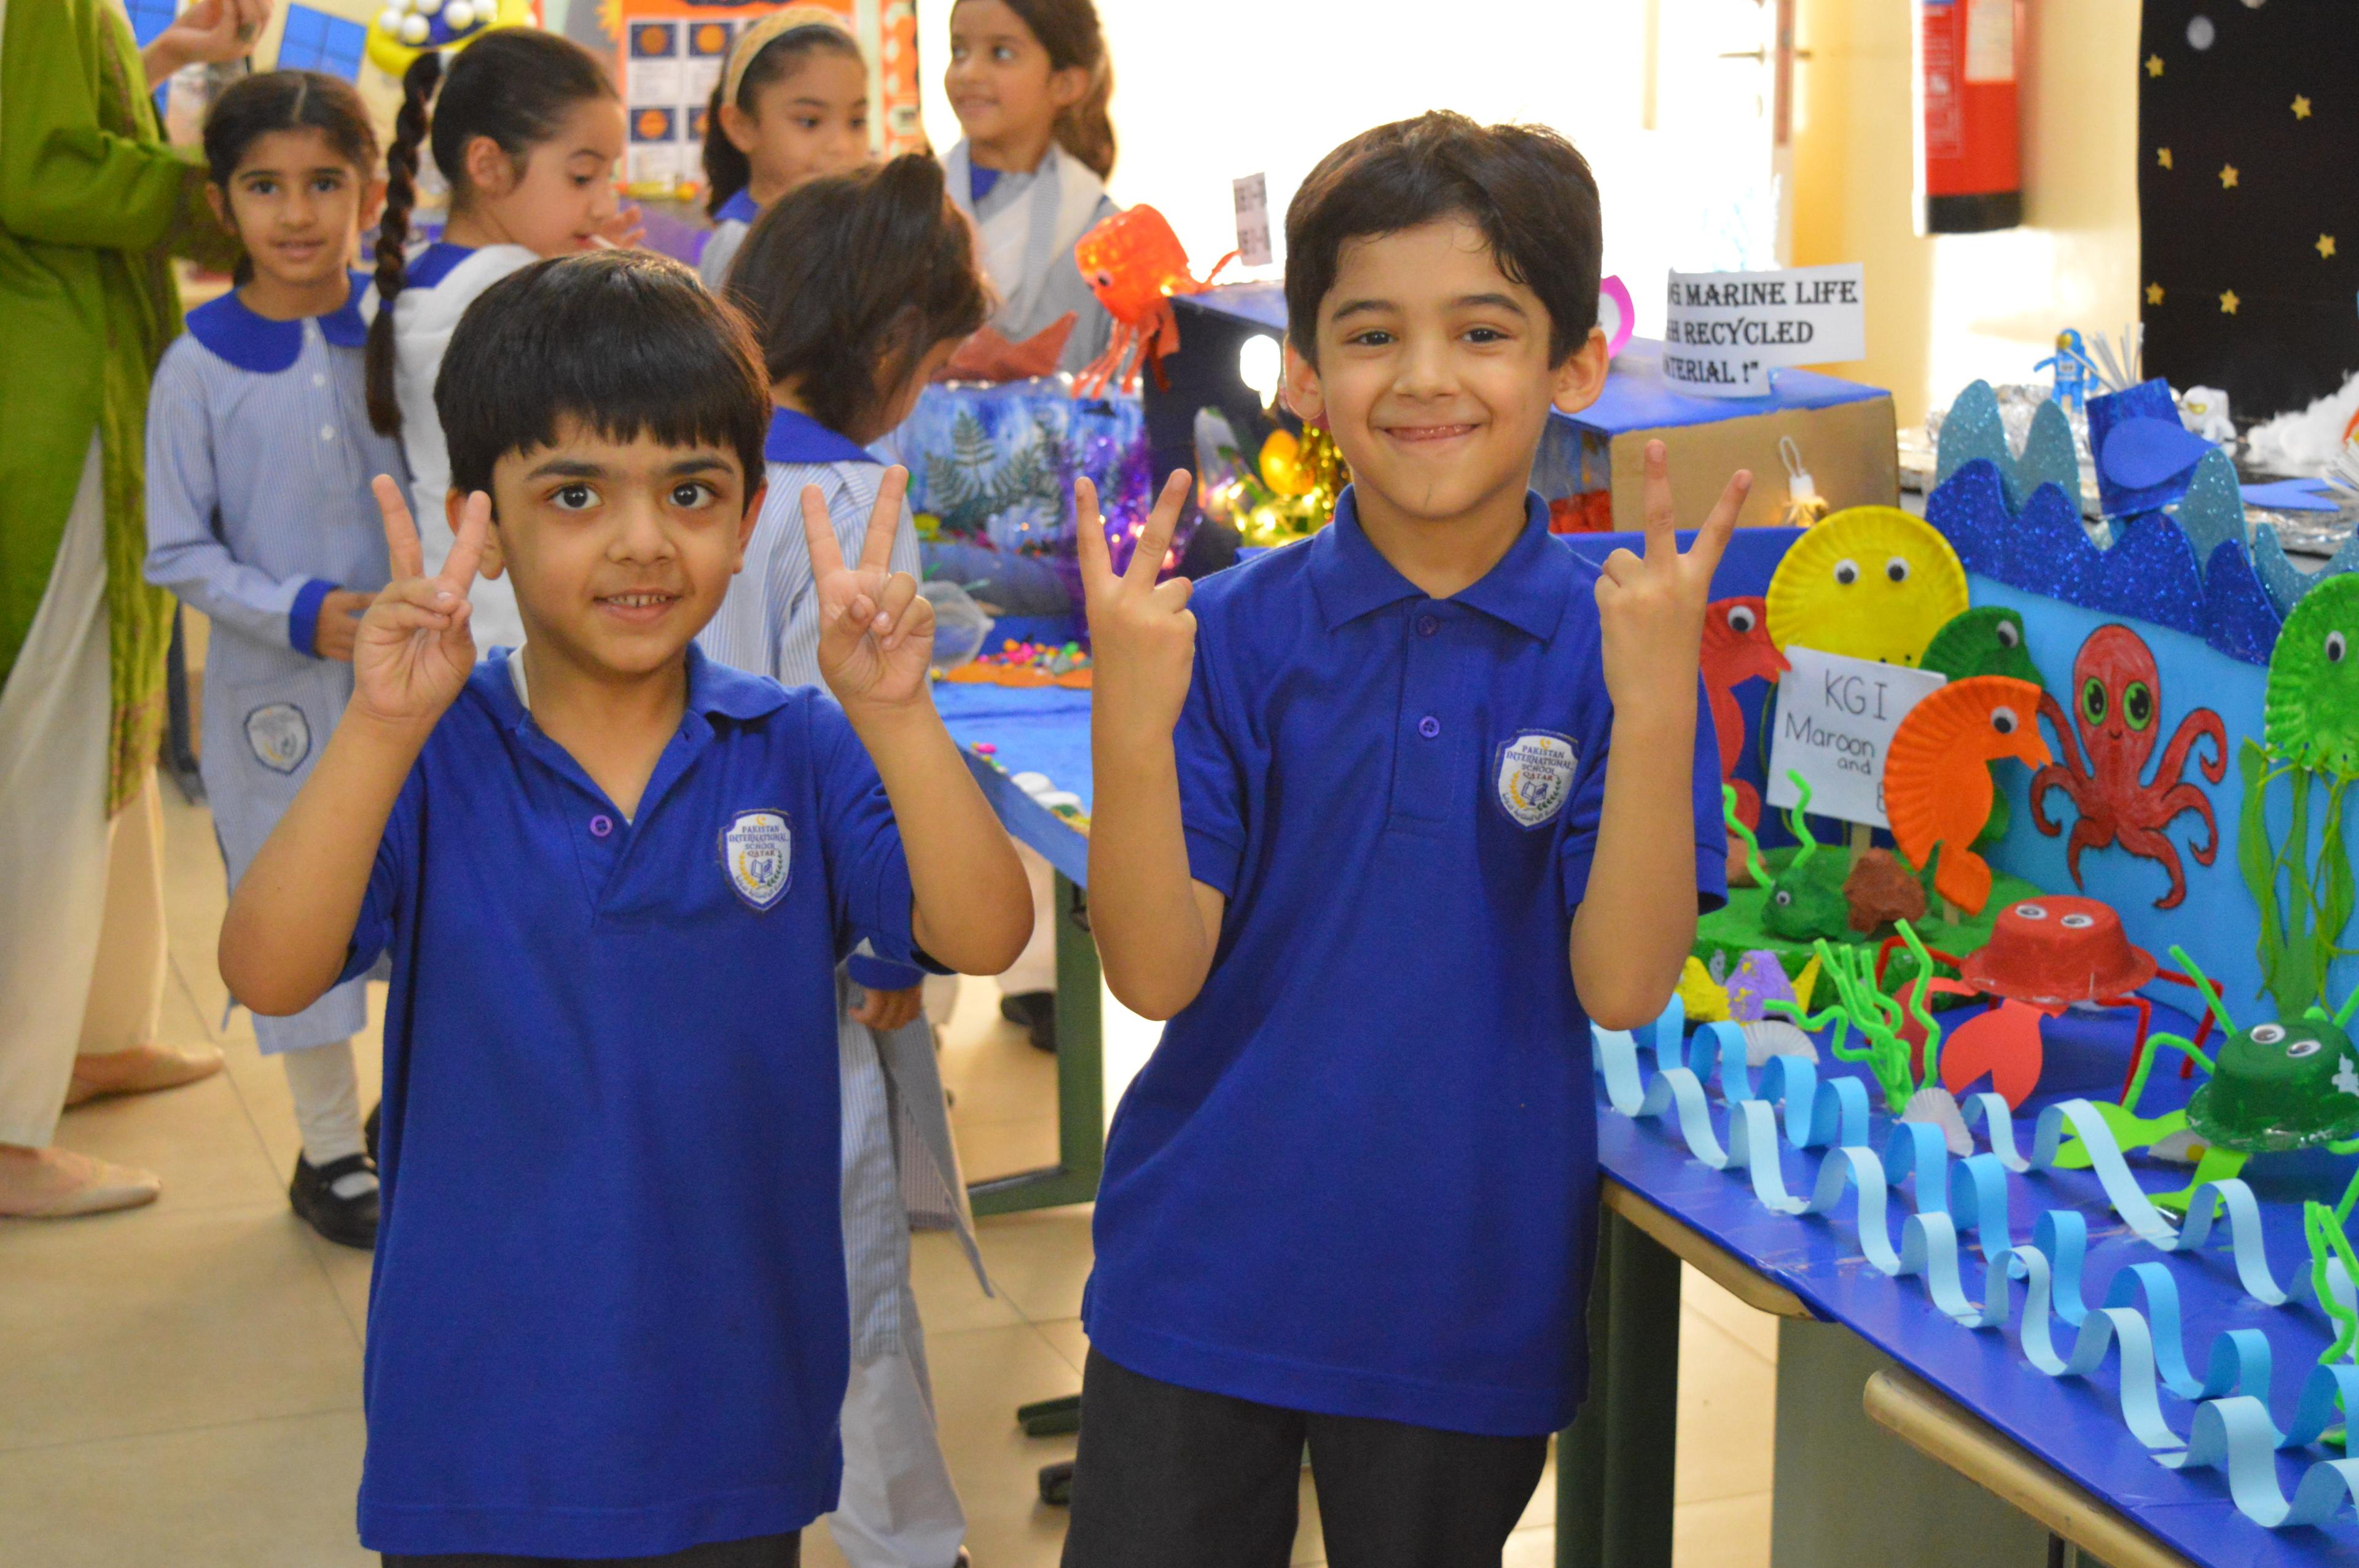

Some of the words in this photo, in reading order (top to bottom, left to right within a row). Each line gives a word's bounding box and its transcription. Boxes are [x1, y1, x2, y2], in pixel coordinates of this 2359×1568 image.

[1686, 283, 1786, 307] MARINE
[1795, 280, 1858, 305] LIFE
[1684, 317, 1814, 345] RECYCLED
[1785, 712, 1876, 758] Maroon
[1506, 751, 1573, 770] INTERNATIONAL
[1522, 745, 1565, 759] PAKISTAN
[1522, 763, 1555, 774] SCHOOL
[1837, 757, 1871, 775] and
[1523, 771, 1553, 781] QATAR
[729, 833, 789, 843] INTERNATIONAL
